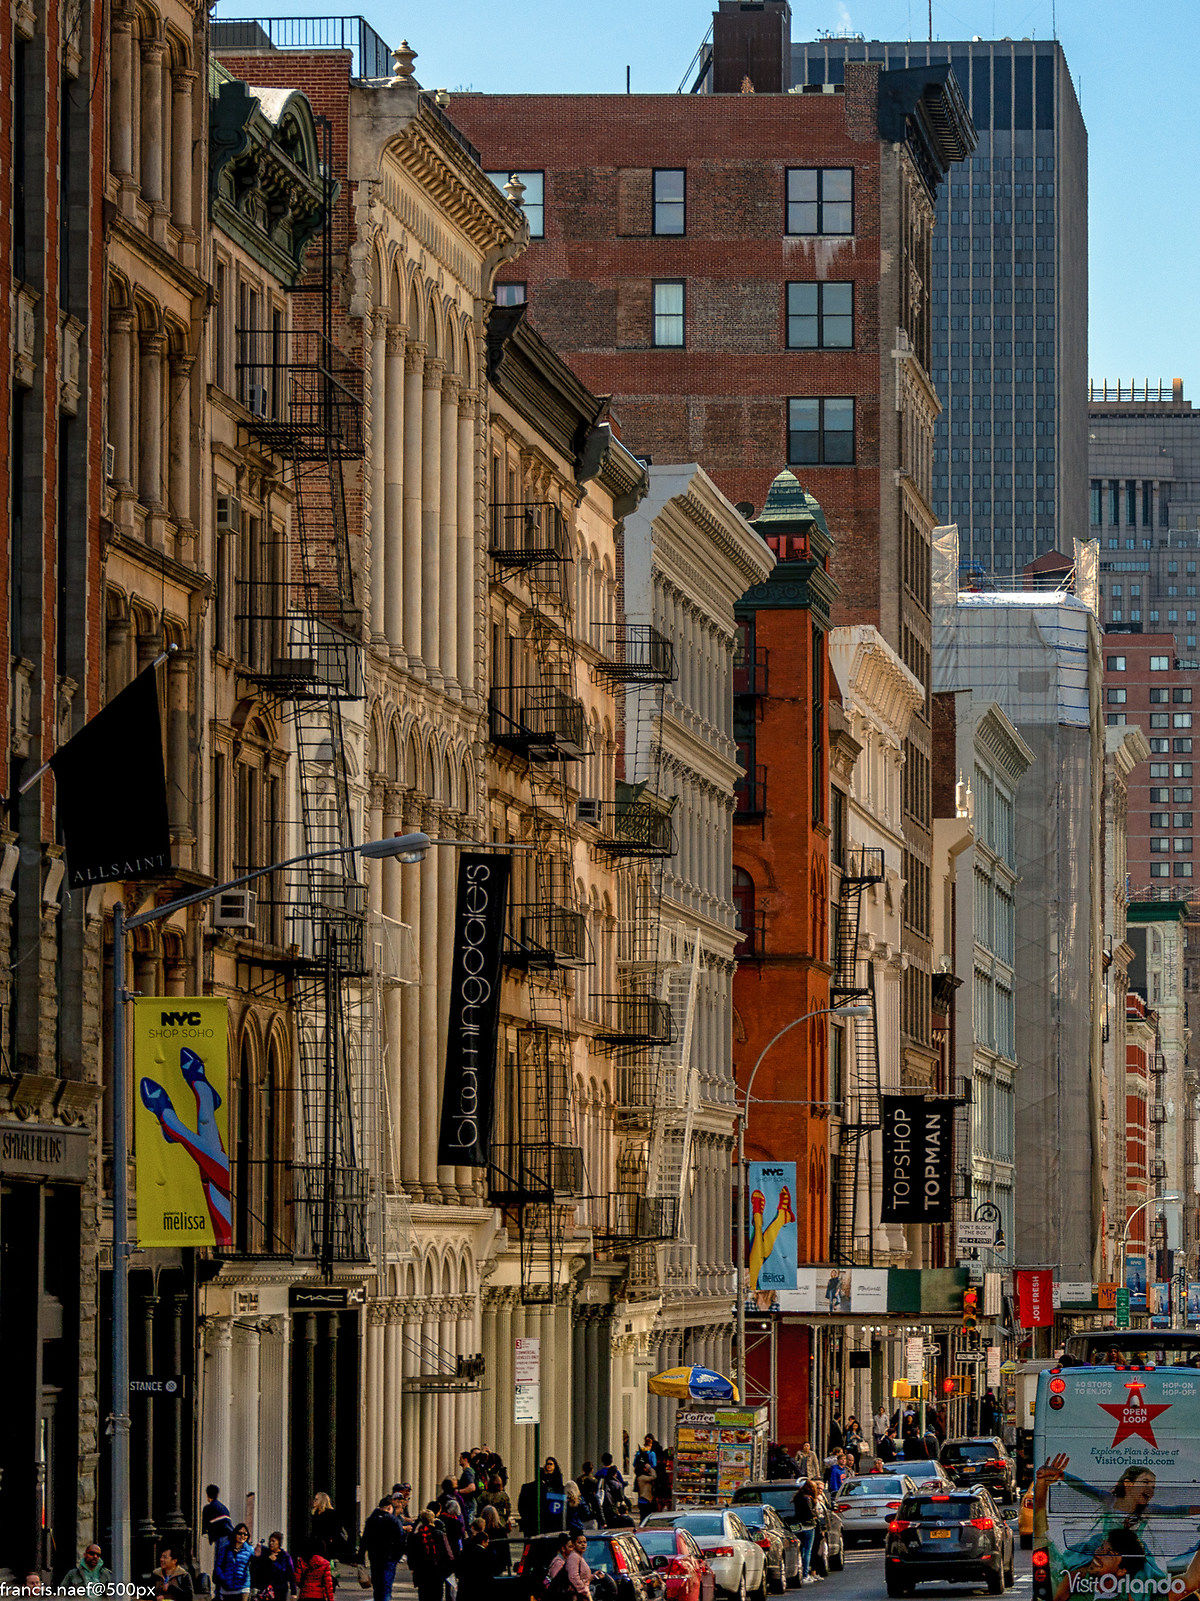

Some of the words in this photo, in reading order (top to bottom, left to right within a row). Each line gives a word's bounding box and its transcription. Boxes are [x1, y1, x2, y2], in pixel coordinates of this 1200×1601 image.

[161, 1012, 201, 1026] NYC
[148, 1029, 178, 1038] SHOP
[182, 1029, 213, 1038] SOHO
[893, 1109, 911, 1210] TOPSHOP
[924, 1114, 941, 1210] TOPMAN
[762, 1168, 784, 1176] NYC
[164, 1212, 206, 1230] melissa
[1032, 1276, 1040, 1303] FRESH
[1032, 1305, 1040, 1321] JOE
[130, 1381, 163, 1391] STANCE
[685, 1413, 714, 1421] Coffee
[1090, 1448, 1121, 1456] Explore,
[1095, 1457, 1175, 1465] VisitOrlando.com
[1060, 1569, 1186, 1594] VisitOrlando
